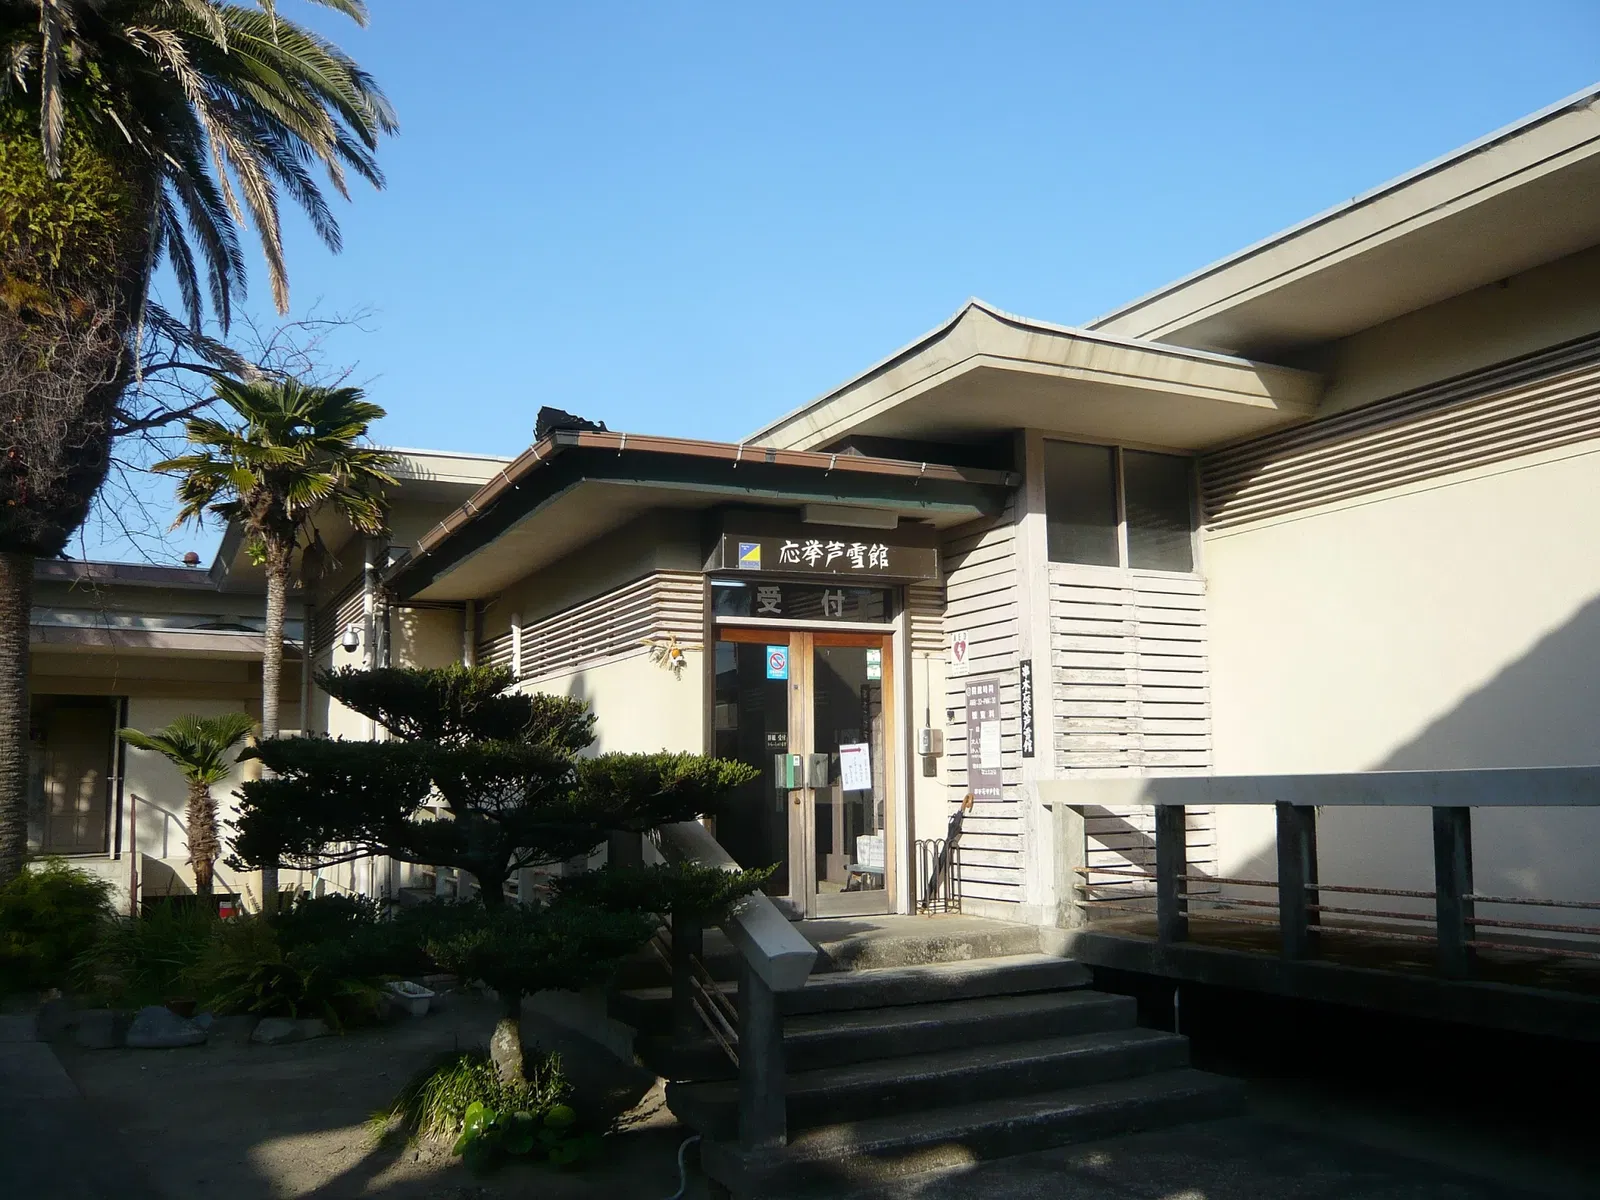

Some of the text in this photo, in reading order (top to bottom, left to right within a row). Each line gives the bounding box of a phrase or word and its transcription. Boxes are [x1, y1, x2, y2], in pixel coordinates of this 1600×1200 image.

[779, 540, 889, 570] 応挙芦雪館
[757, 586, 845, 617] 受付
